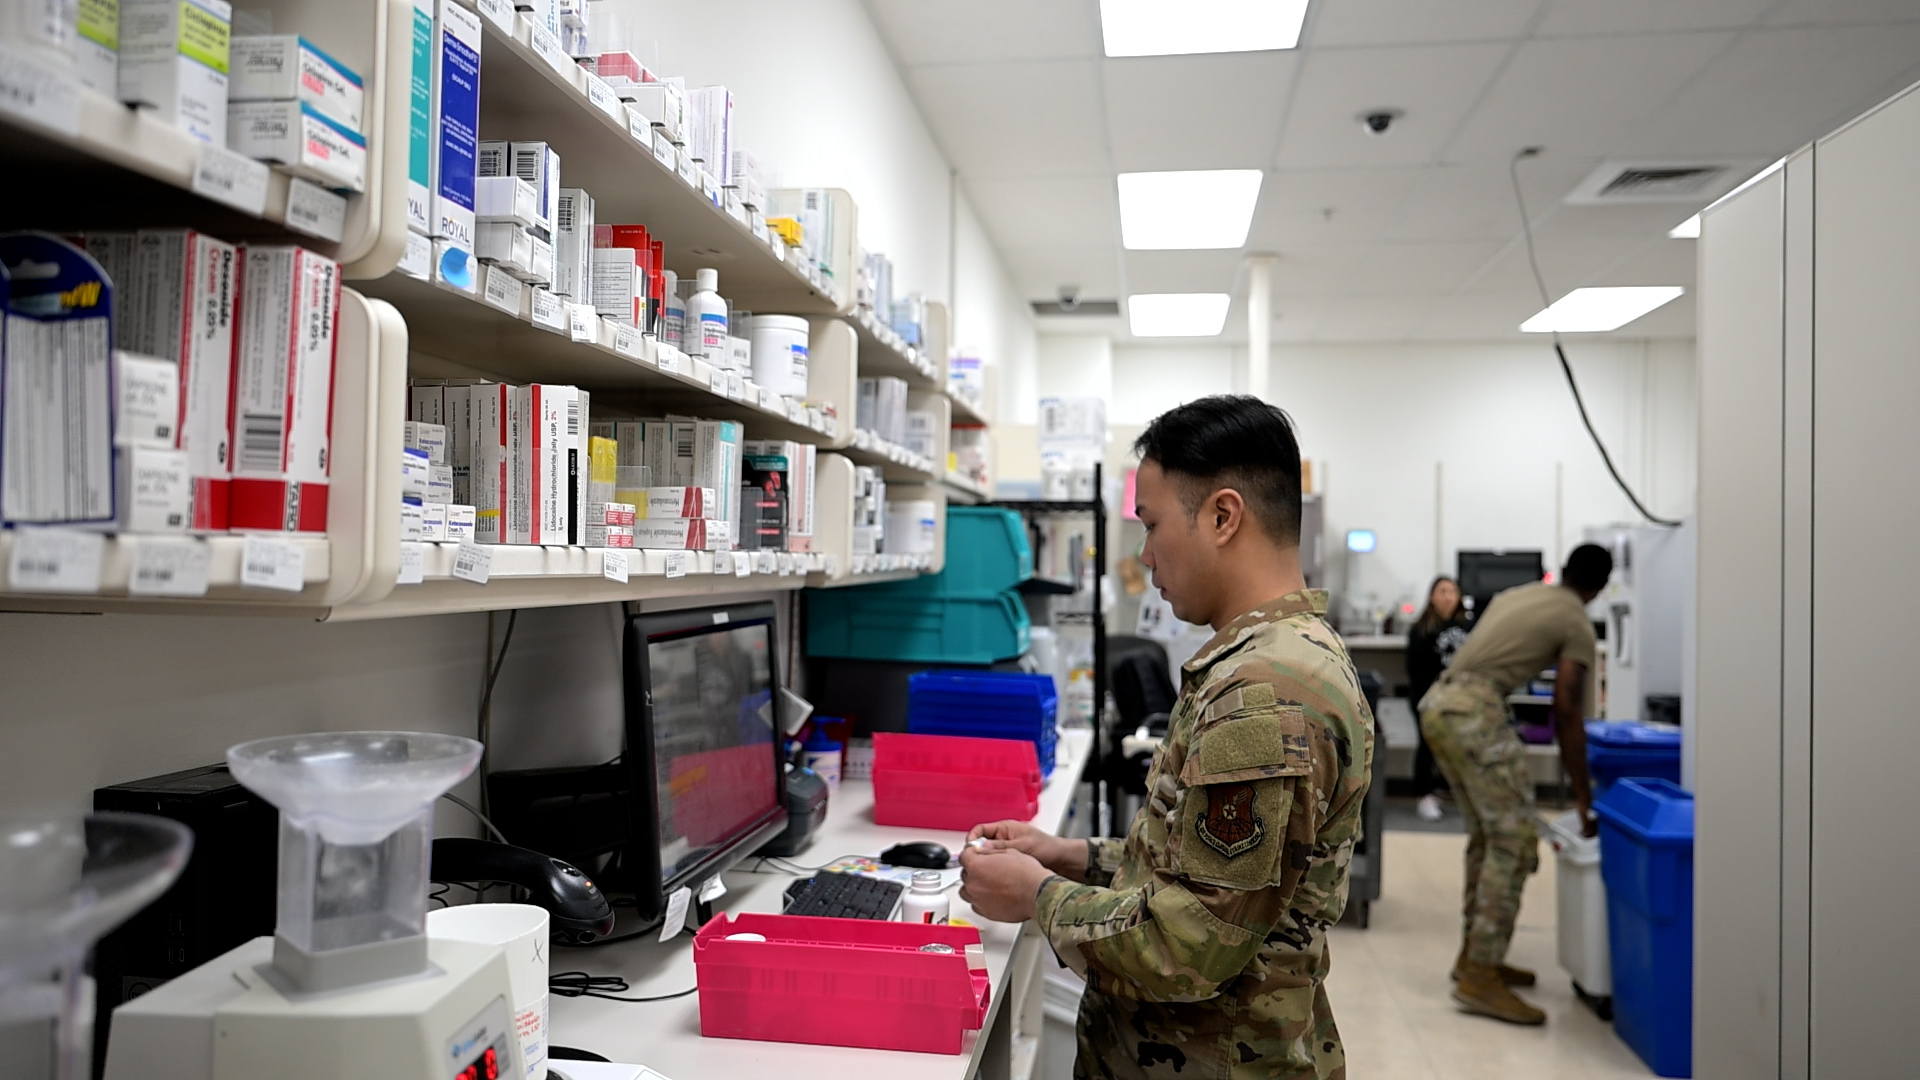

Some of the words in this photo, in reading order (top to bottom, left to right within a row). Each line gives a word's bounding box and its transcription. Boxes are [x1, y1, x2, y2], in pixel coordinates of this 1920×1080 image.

[442, 216, 470, 243] ROYAL
[219, 249, 232, 328] Desonide
[321, 265, 334, 340] Desonide
[551, 410, 557, 421] 2%
[551, 454, 559, 499] Hydrochloride
[286, 482, 299, 532] TARO
